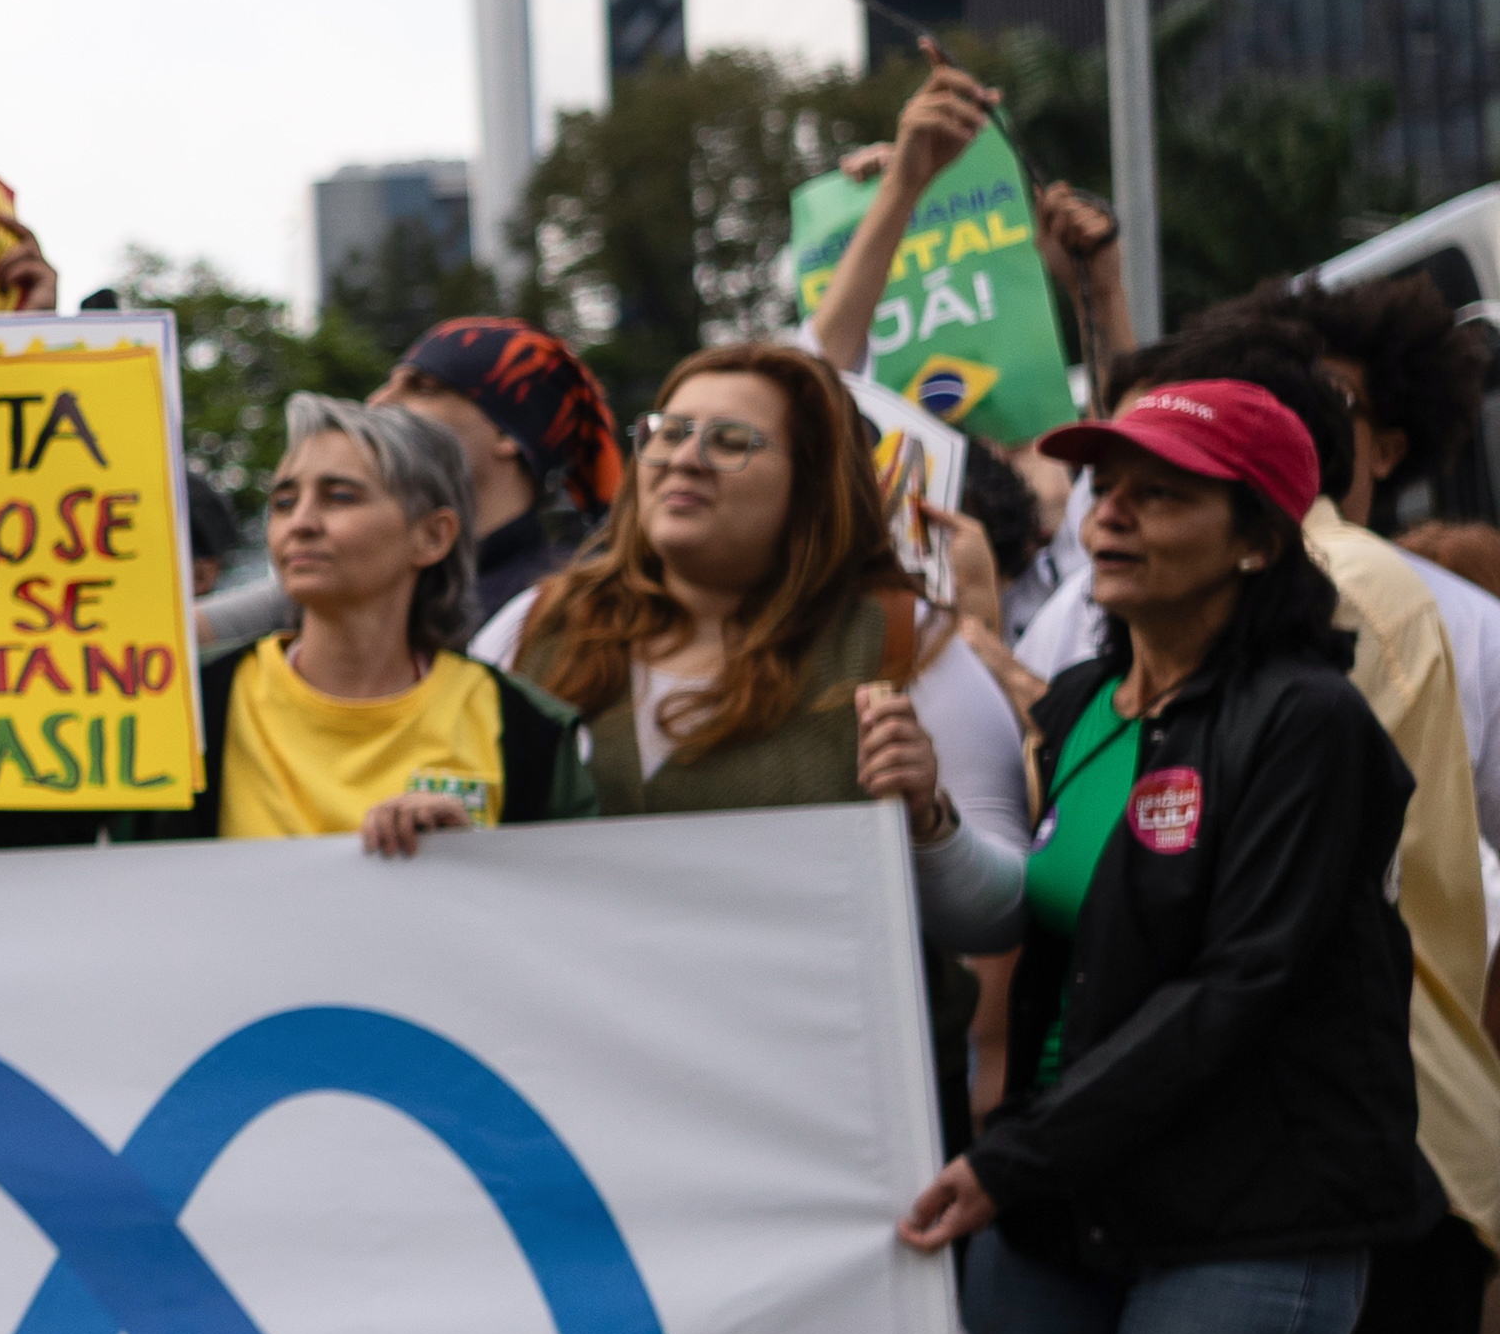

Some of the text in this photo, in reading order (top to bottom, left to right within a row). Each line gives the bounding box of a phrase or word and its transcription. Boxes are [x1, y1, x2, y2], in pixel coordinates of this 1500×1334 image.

[54, 487, 141, 562] SE
[13, 575, 115, 634] SE
[82, 642, 176, 698] NO
